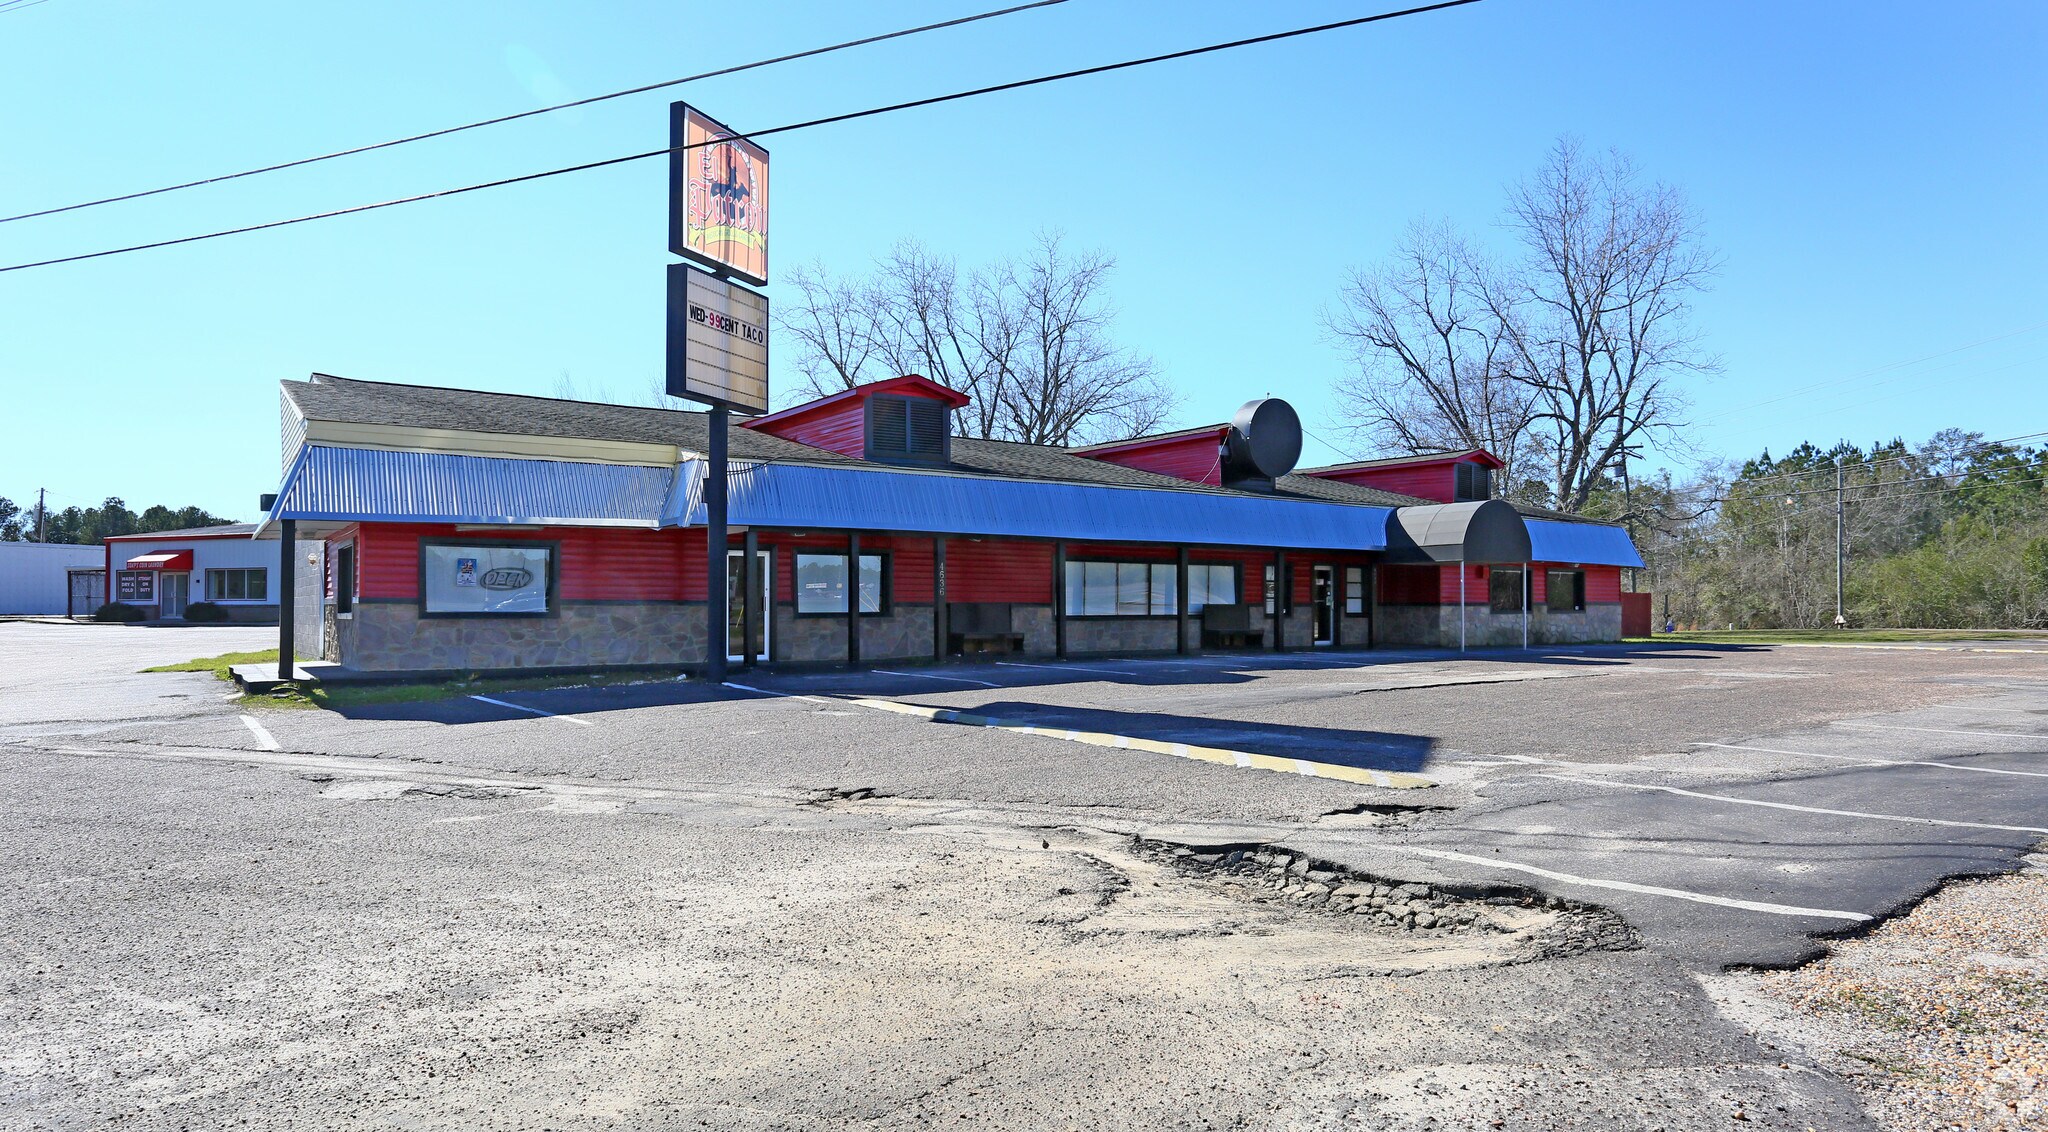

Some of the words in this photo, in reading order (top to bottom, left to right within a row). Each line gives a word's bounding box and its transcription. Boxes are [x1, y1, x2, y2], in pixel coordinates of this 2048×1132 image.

[697, 151, 718, 182] El
[742, 324, 764, 344] TACO
[485, 571, 528, 587] OPEN
